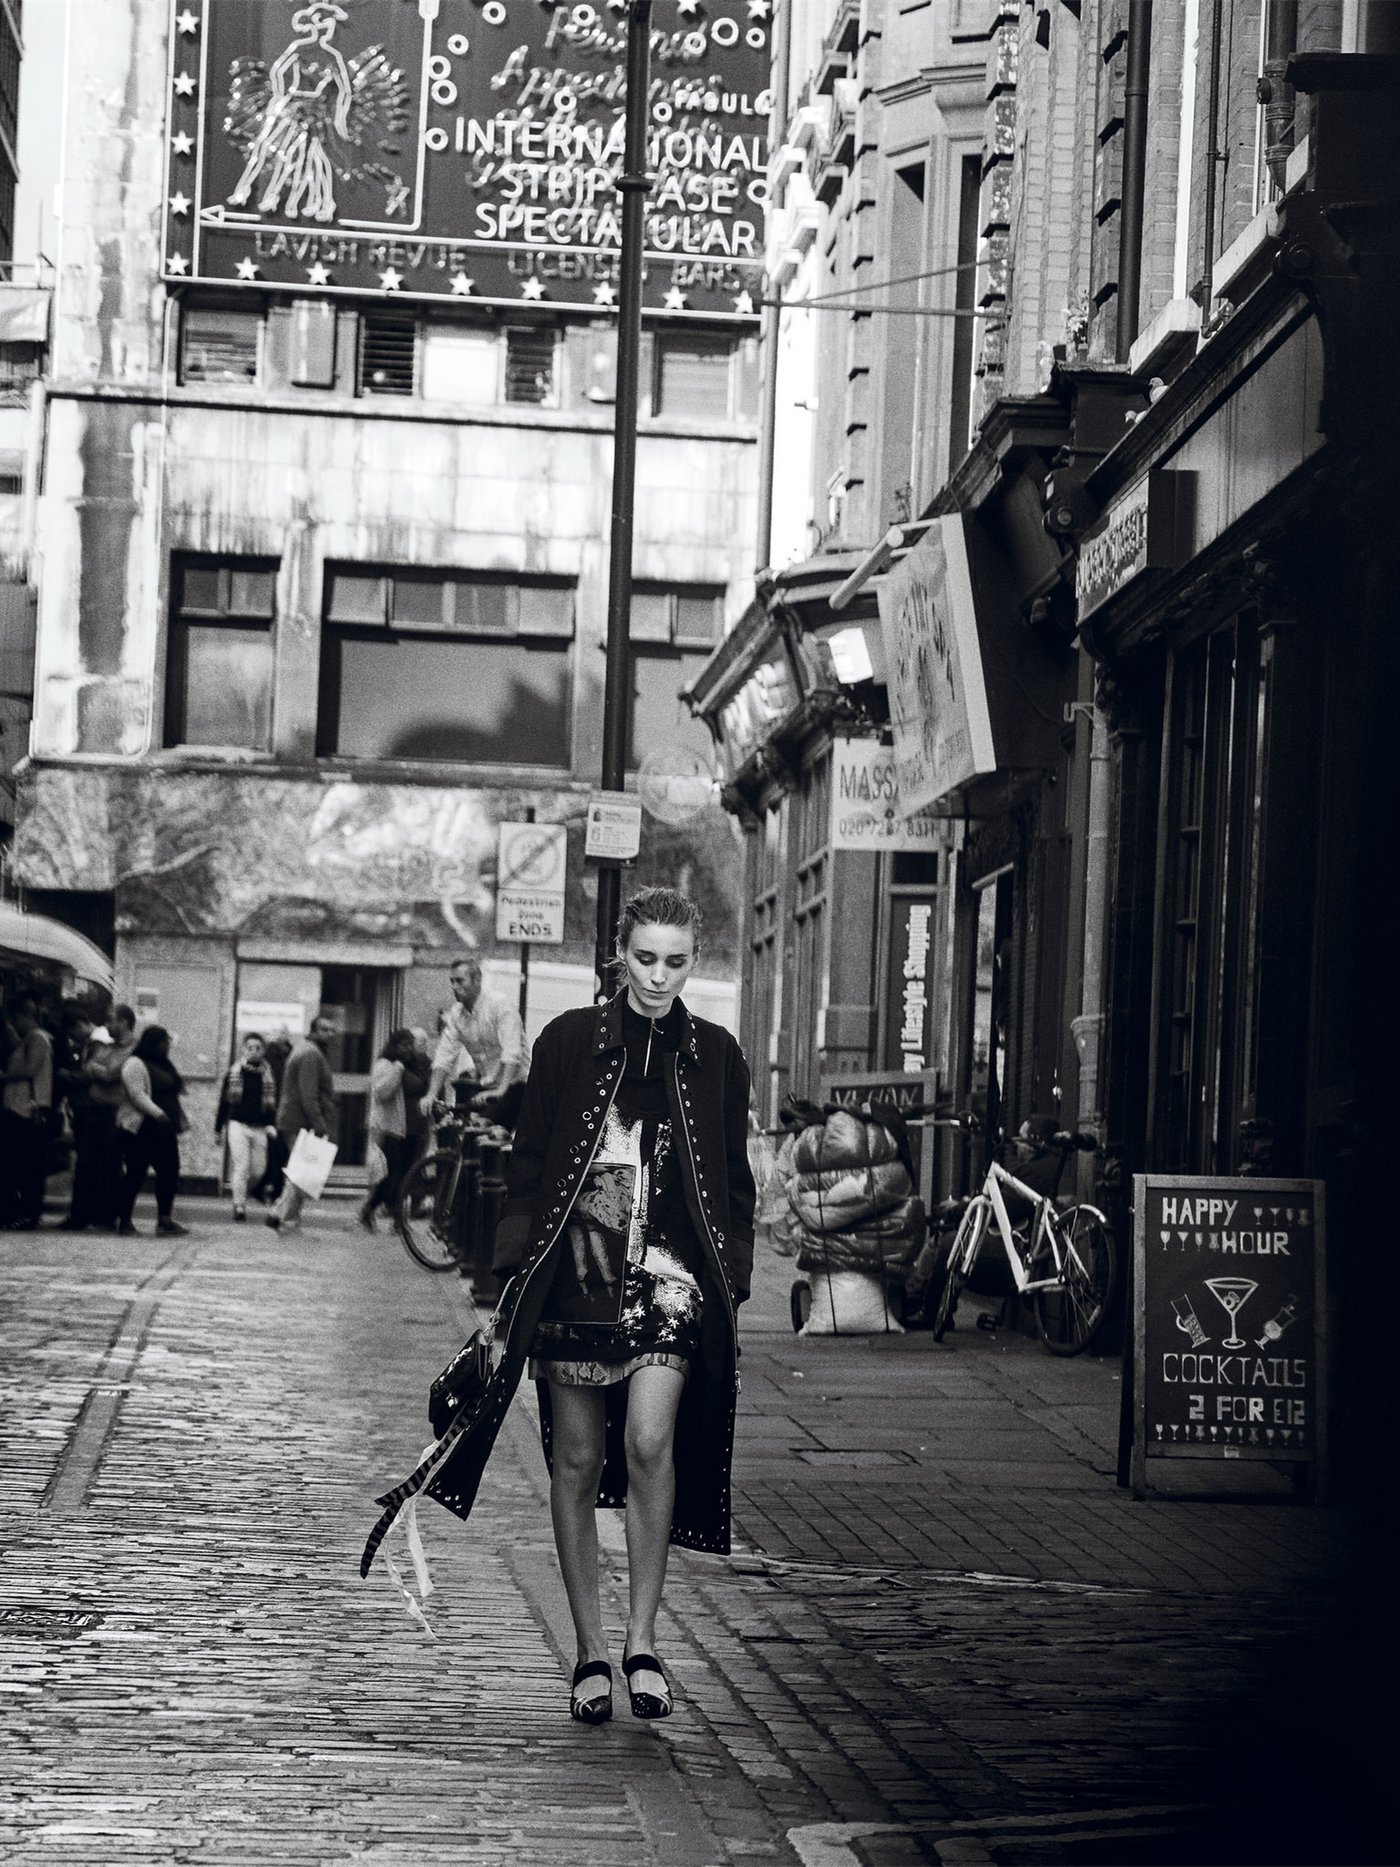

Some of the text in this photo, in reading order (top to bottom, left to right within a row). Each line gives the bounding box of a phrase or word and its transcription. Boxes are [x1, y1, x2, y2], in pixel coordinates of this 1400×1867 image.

[455, 116, 767, 173] INTERNAIONAL
[500, 162, 736, 214] STRIPASE
[474, 201, 756, 257] SPECTAULAR
[255, 232, 465, 272] LAVISH REVUE
[507, 250, 641, 281] LICENSE
[839, 763, 899, 801] MASS
[508, 922, 552, 937] ENDS
[1162, 1197, 1238, 1225] HAPPY
[1222, 1231, 1290, 1255] HOUR
[1163, 1353, 1306, 1387] COCKTAILS
[1188, 1395, 1204, 1420] 2
[1216, 1396, 1264, 1422] FOR
